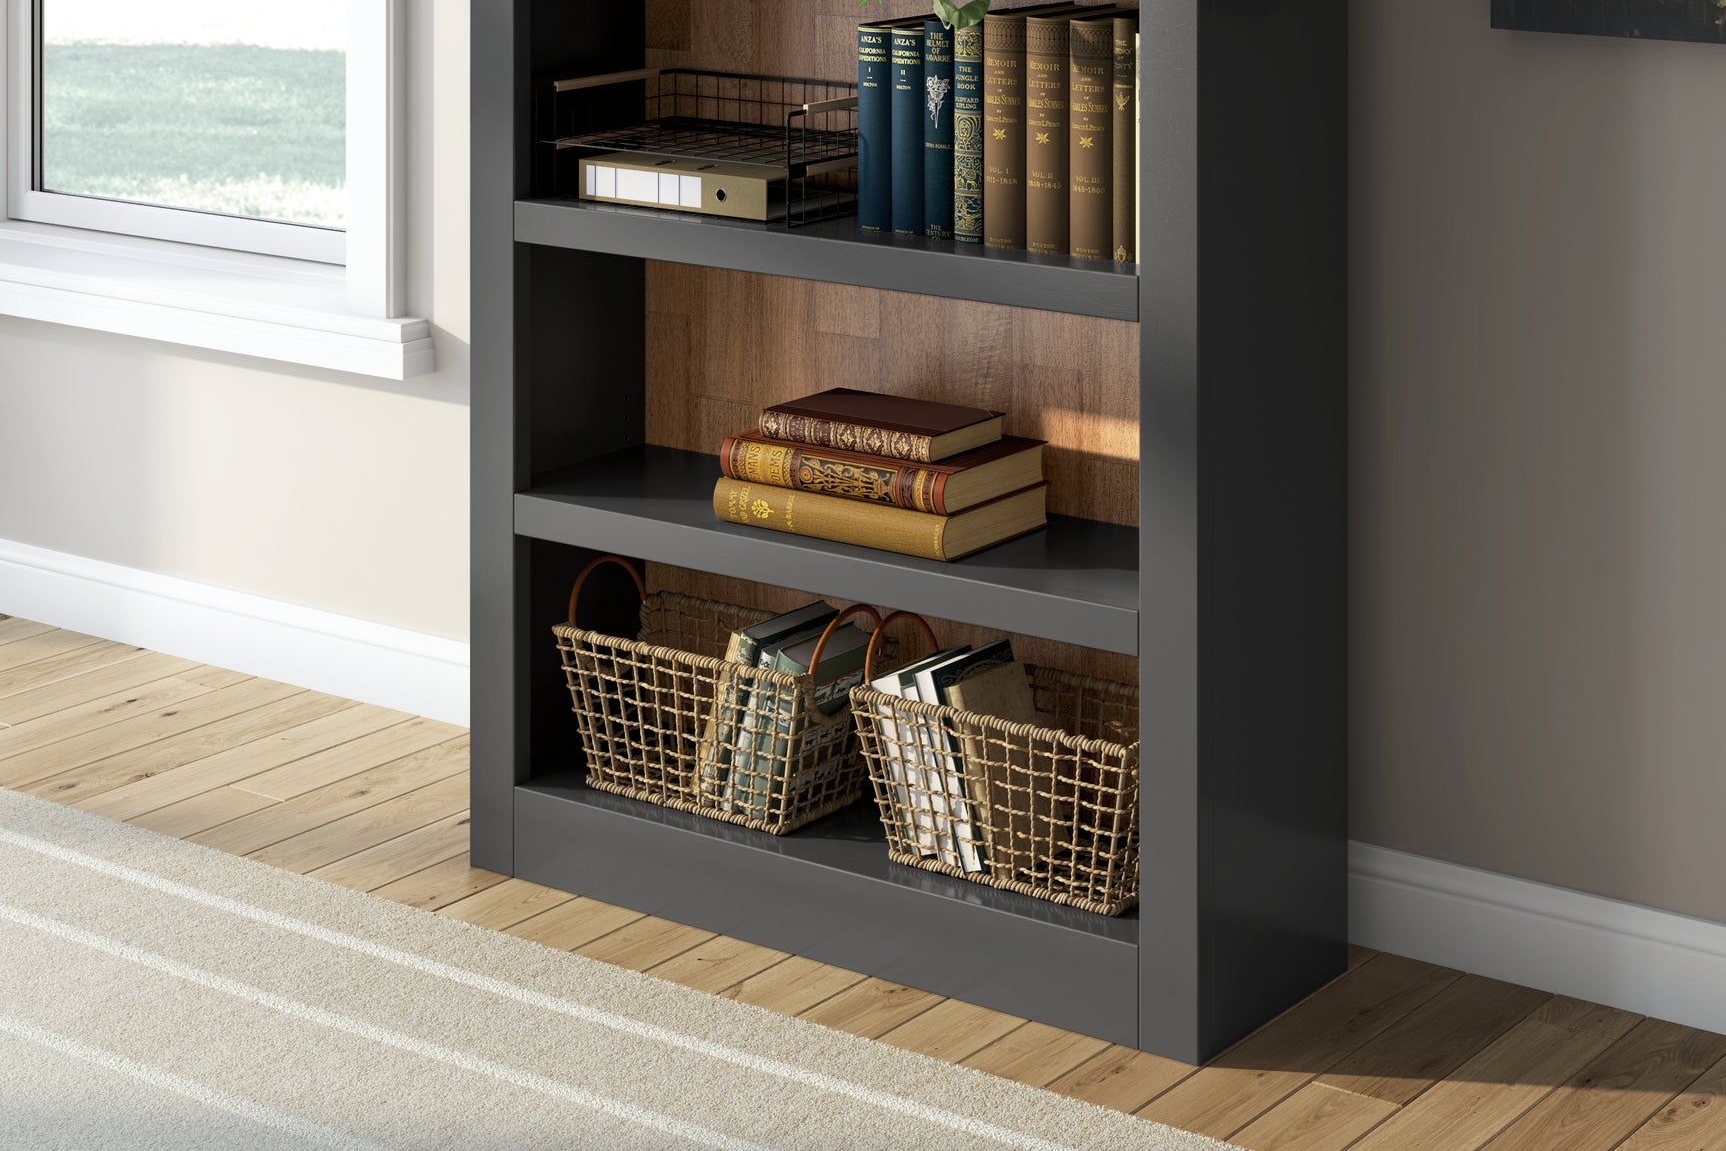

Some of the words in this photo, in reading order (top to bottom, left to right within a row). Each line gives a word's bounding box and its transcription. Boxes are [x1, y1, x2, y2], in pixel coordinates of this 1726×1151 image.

[861, 35, 882, 44] ANZA'S
[929, 32, 944, 40] THE
[894, 38, 916, 46] ANZA'S
[987, 57, 1017, 67] MEMOIR
[1029, 61, 1060, 71] MEMOIR
[1072, 64, 1105, 75] MEMOIR
[986, 74, 1018, 85] LETTERS
[1028, 78, 1062, 89] LETTERS
[957, 82, 976, 90] BOOK
[1071, 81, 1105, 92] LETTERS
[729, 490, 738, 518] TOMMY
